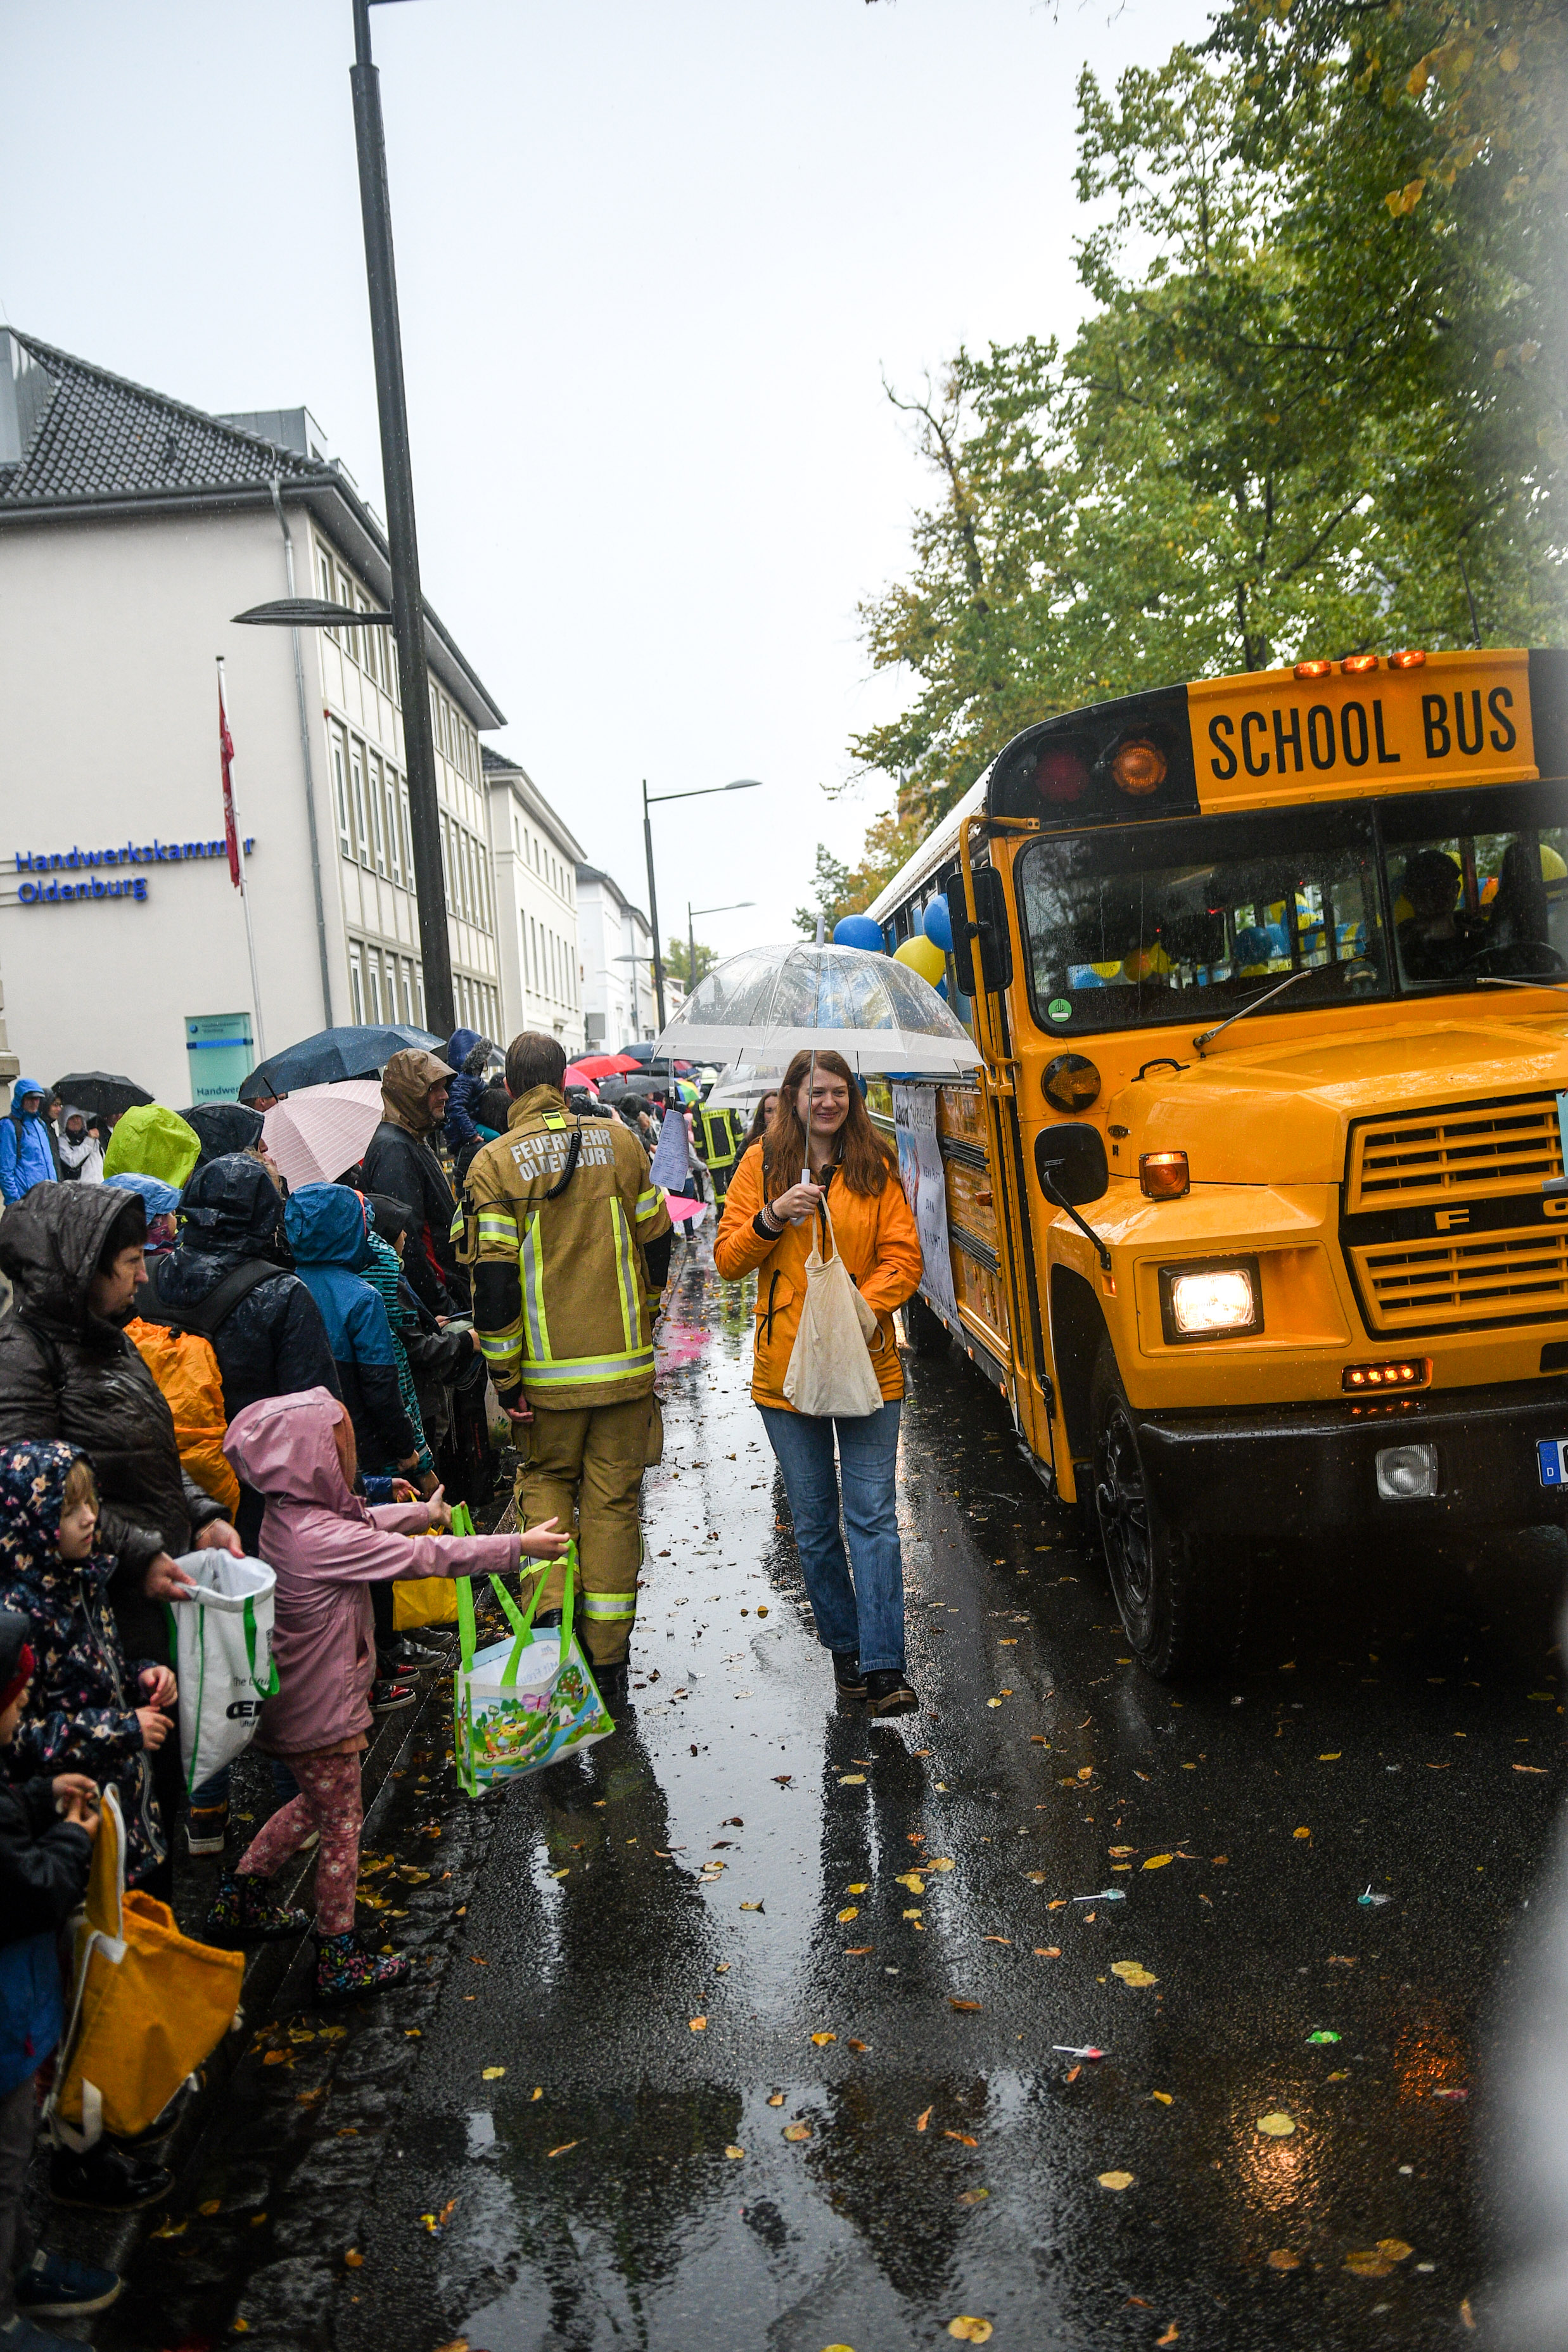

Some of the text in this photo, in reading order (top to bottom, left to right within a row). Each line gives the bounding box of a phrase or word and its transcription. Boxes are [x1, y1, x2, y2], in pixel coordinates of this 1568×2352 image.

[1208, 686, 1517, 780] SCHOOL BUS
[15, 837, 255, 872] Handwerkskammr
[17, 876, 148, 904] Oldenburg
[196, 1085, 242, 1096] Handwer
[1546, 1467, 1554, 1477] D
